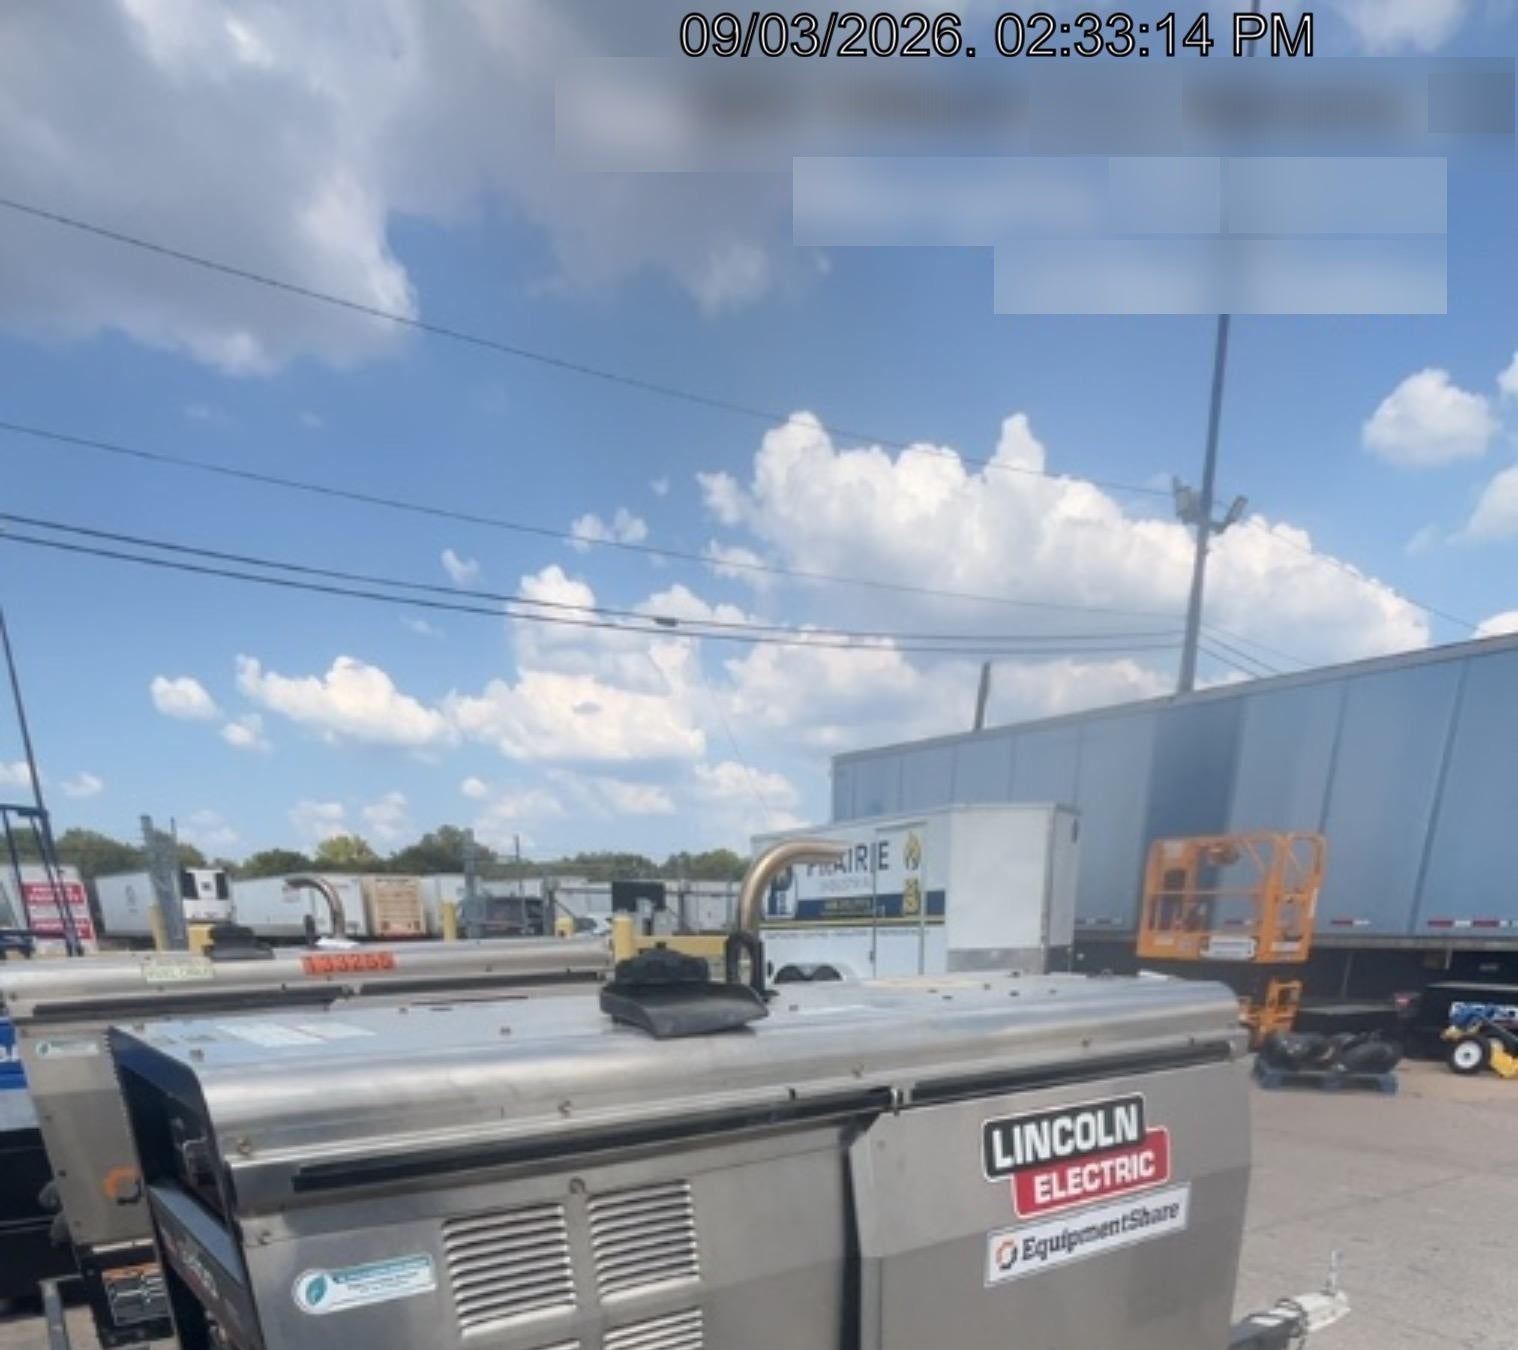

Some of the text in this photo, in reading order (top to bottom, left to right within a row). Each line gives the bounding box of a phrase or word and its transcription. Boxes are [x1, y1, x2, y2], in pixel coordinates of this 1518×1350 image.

[992, 1103, 1139, 1169] LINCOLN
[1033, 1150, 1156, 1205] ELECTRIC
[1021, 1202, 1180, 1261] EquipmentShare
